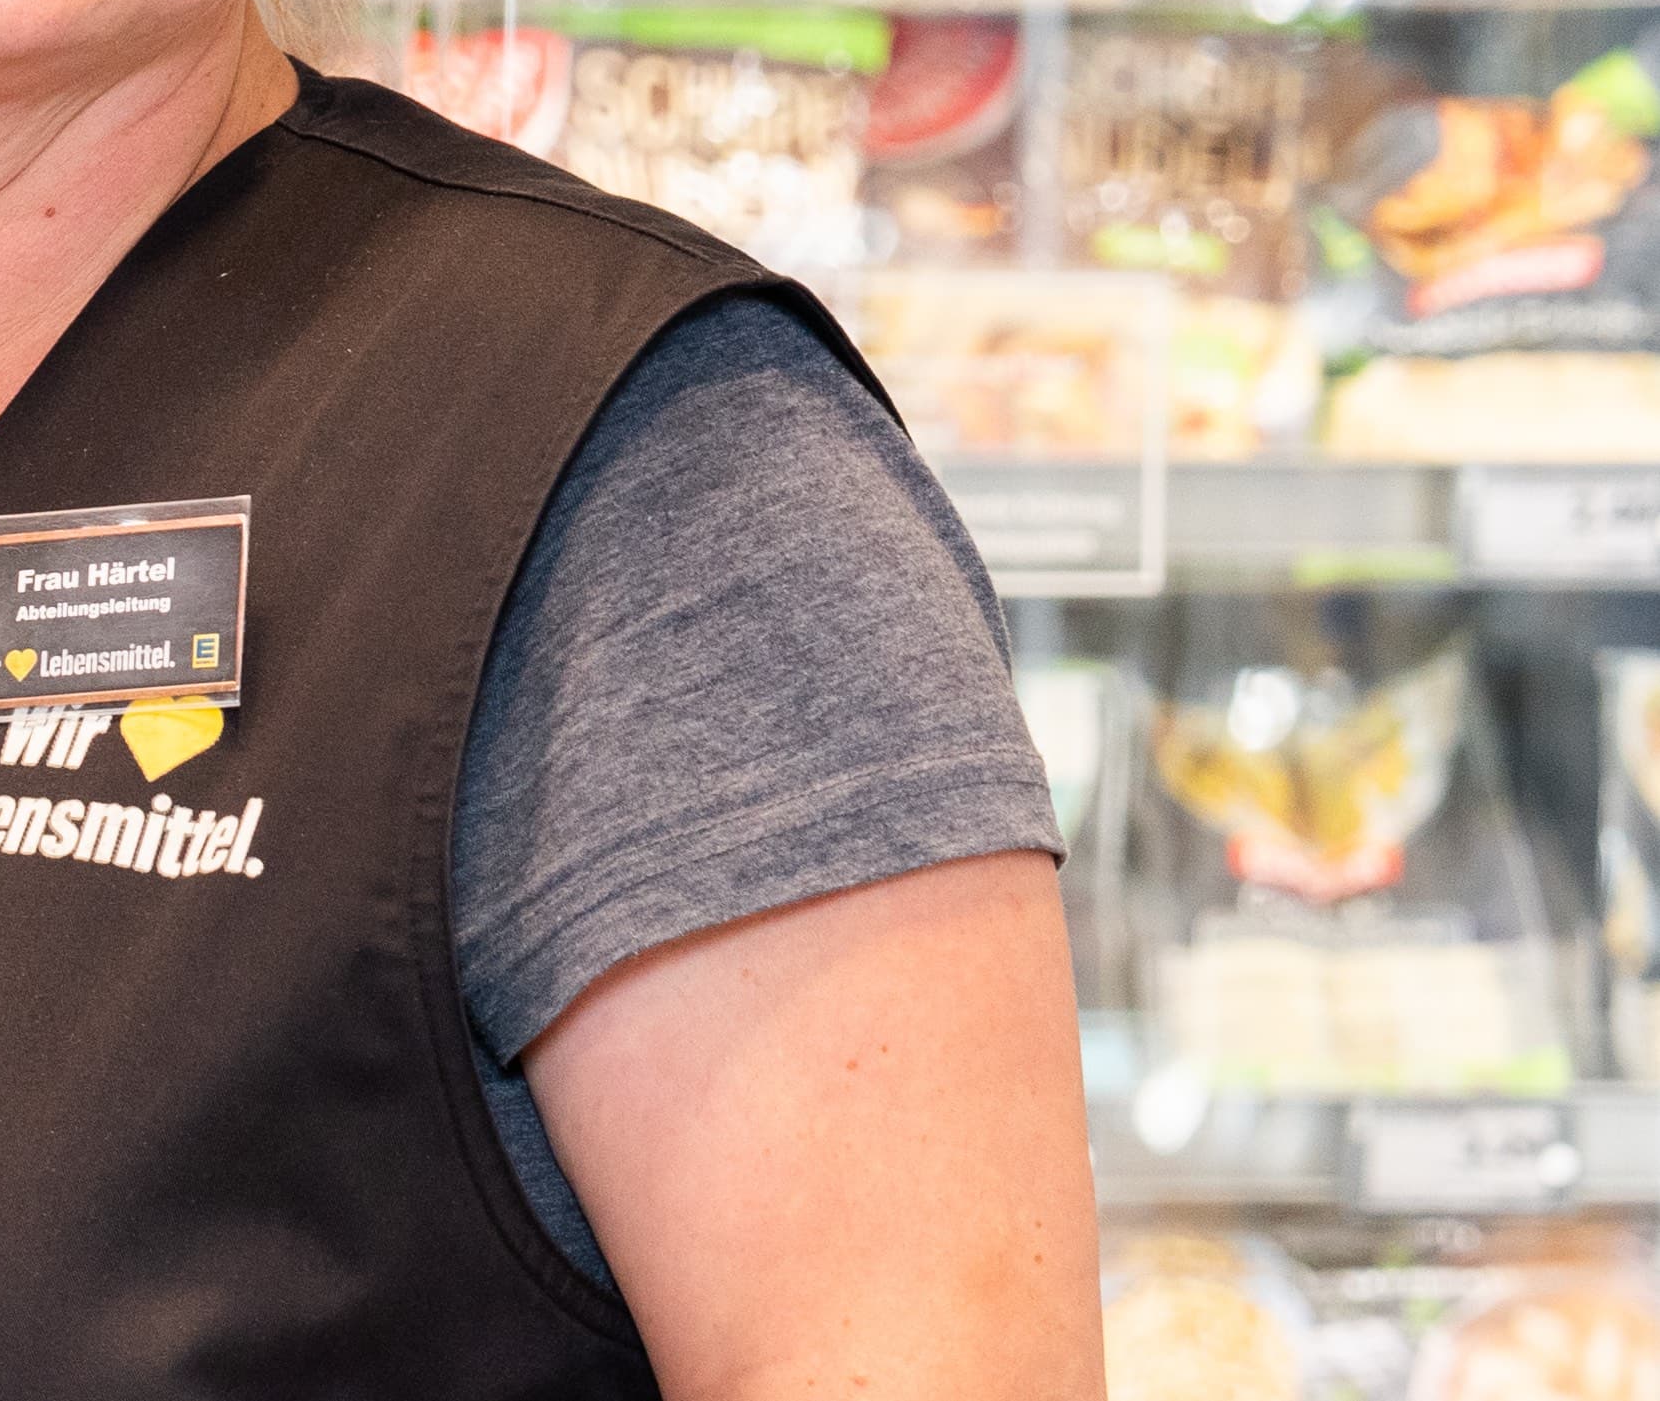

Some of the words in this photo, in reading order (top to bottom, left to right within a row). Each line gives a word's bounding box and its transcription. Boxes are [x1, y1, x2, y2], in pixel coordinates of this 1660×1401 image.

[17, 567, 79, 593] Frau
[87, 556, 176, 587] Härtel
[15, 595, 171, 622] Abteilungsleitung
[40, 639, 176, 678] Lebensmittel.
[0, 703, 112, 770] Wir
